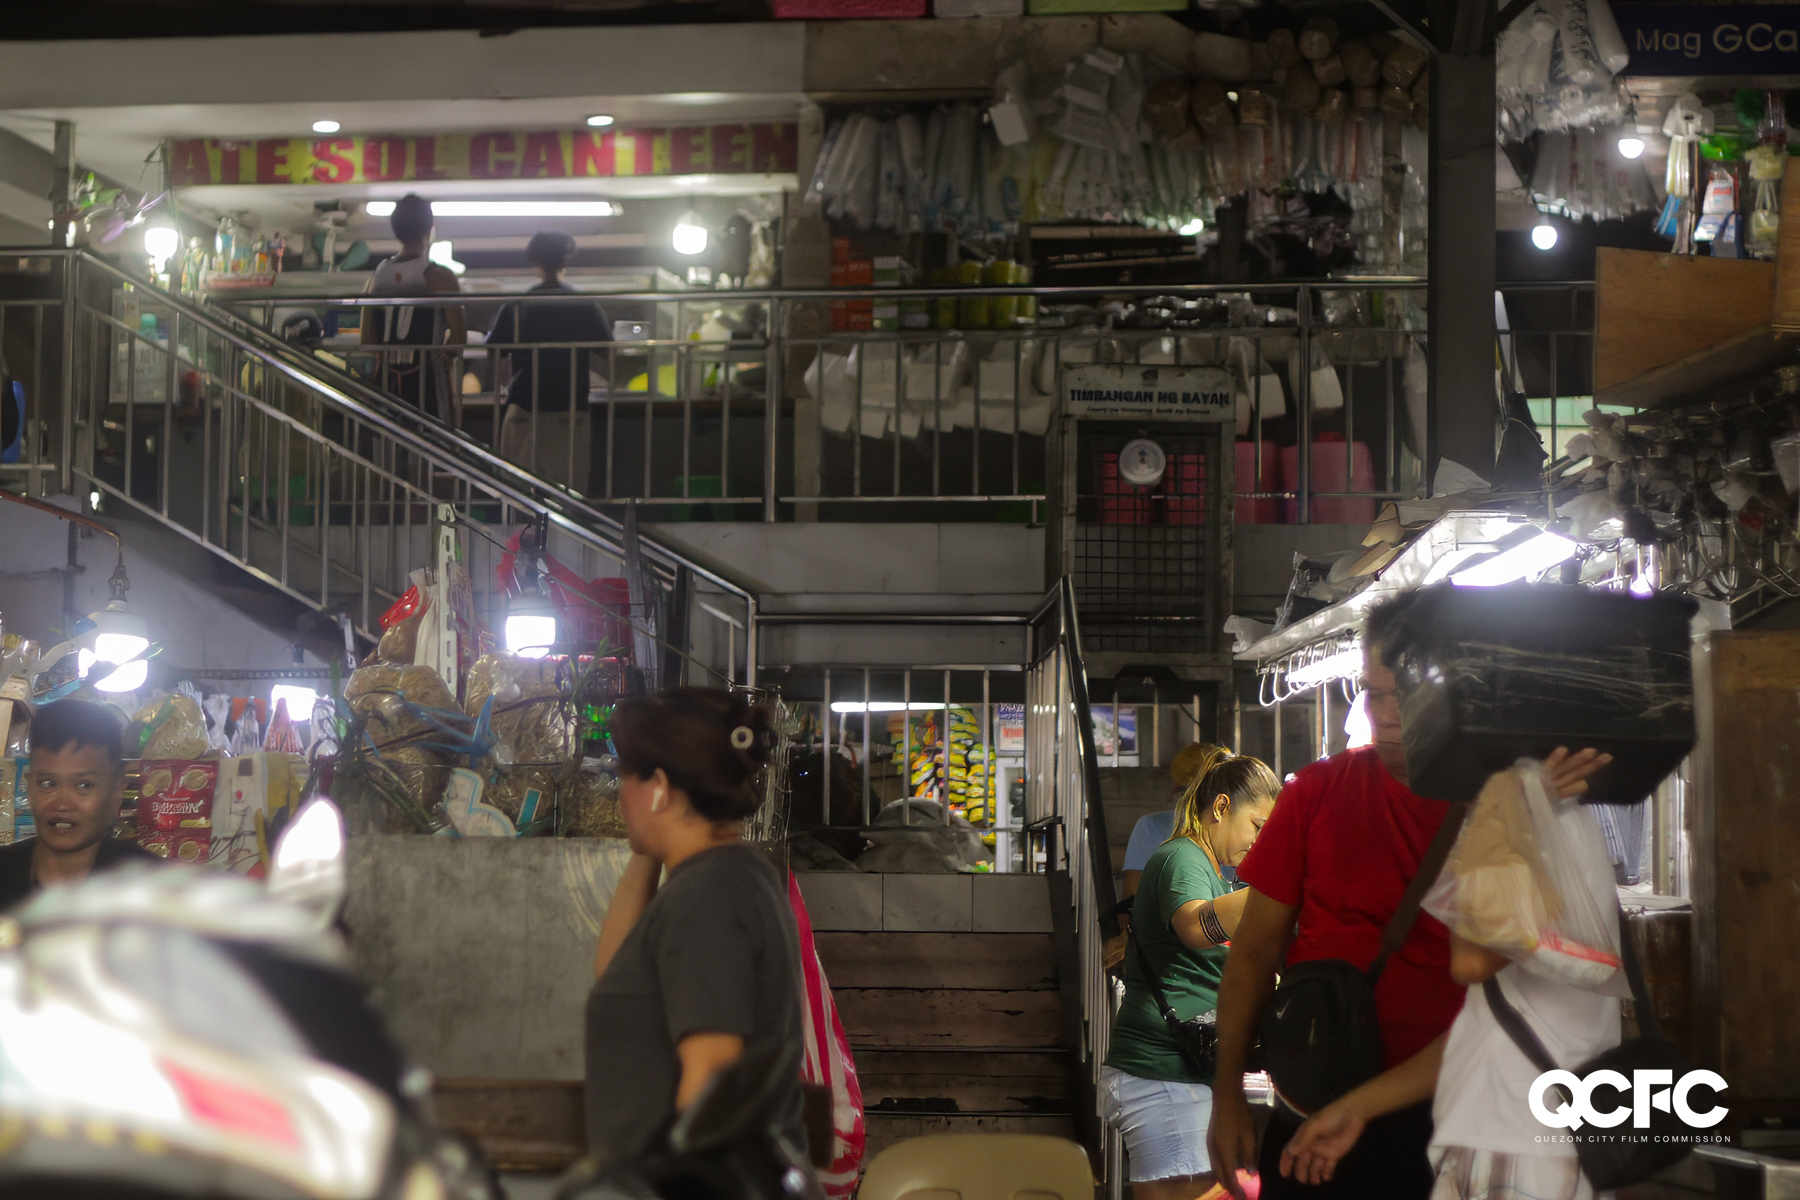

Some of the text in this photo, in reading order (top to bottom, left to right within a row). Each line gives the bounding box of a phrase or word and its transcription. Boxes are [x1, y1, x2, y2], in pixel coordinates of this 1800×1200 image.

[1636, 28, 1701, 59] Mag
[172, 123, 798, 185] ATE SOL CANTEEN
[1070, 389, 1154, 404] TIMBANGAN
[1158, 391, 1178, 405] NG
